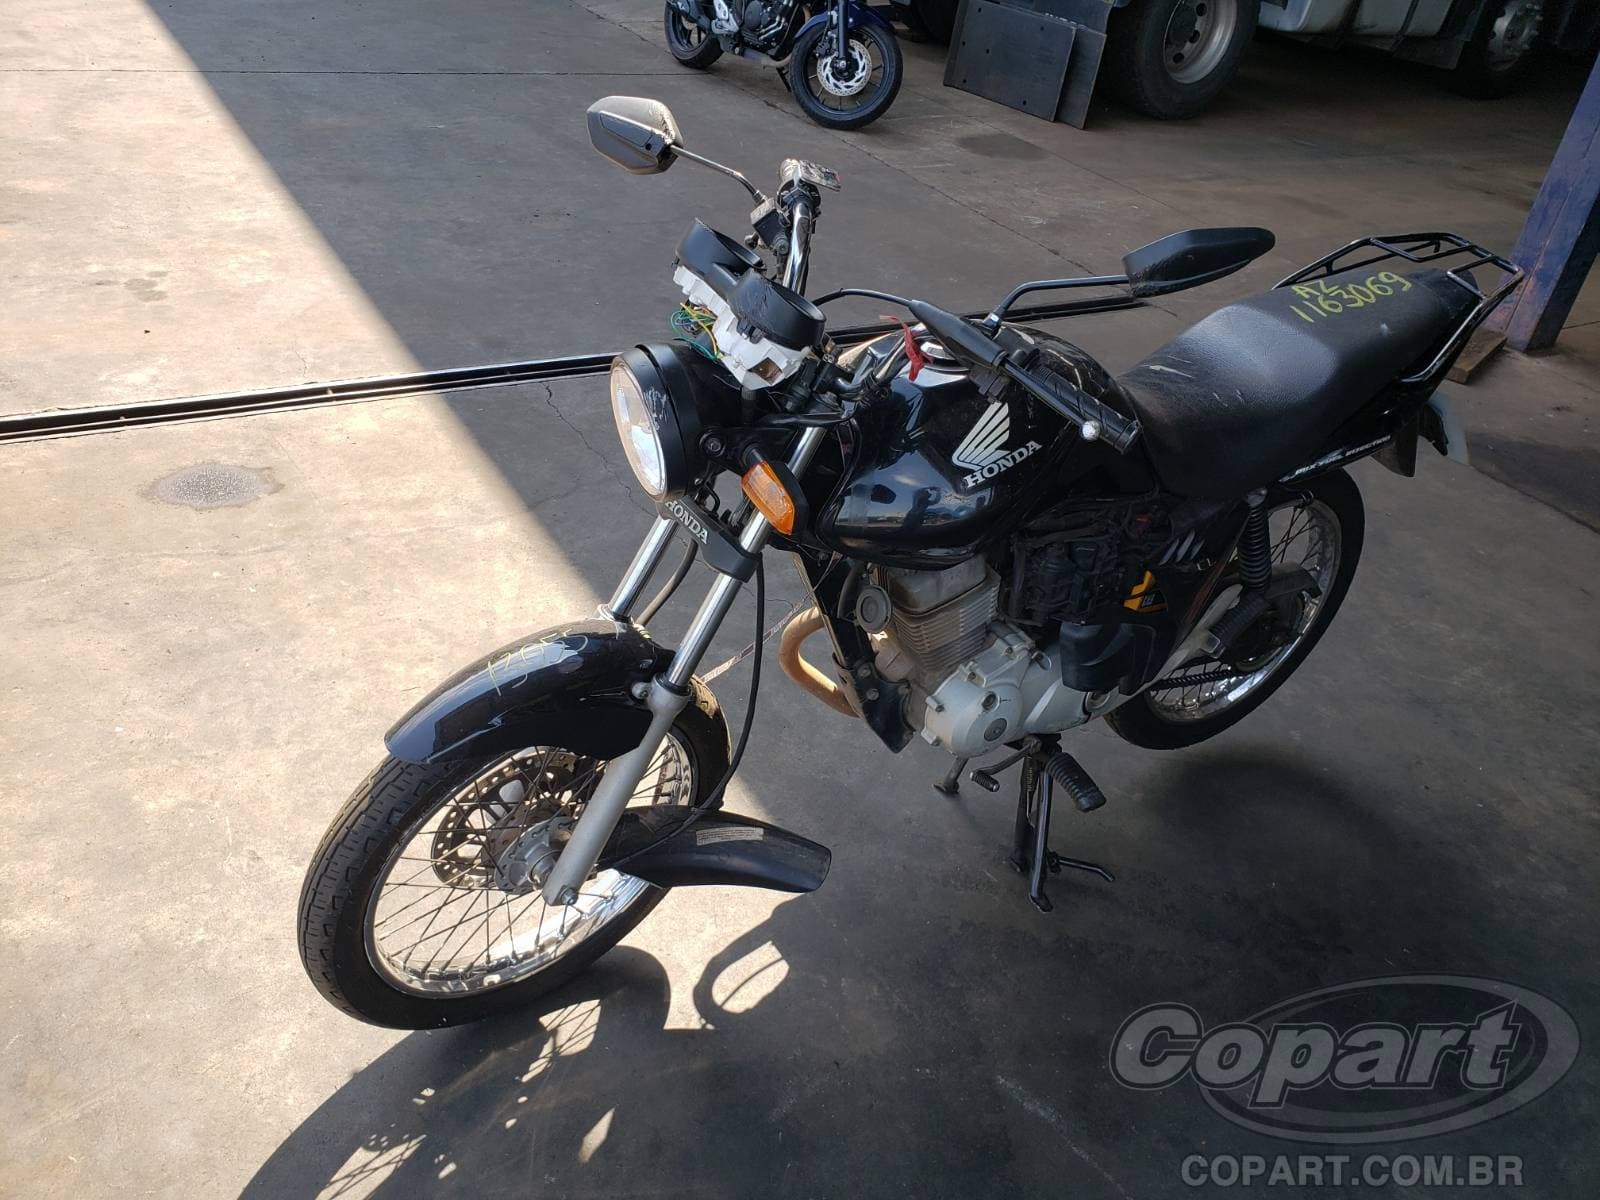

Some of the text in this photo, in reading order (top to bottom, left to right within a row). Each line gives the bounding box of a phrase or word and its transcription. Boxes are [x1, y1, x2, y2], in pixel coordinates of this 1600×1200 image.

[1289, 271, 1413, 323] 1163069
[1291, 279, 1339, 299] AZ
[963, 440, 1043, 488] HONDA
[665, 500, 708, 545] HONDA
